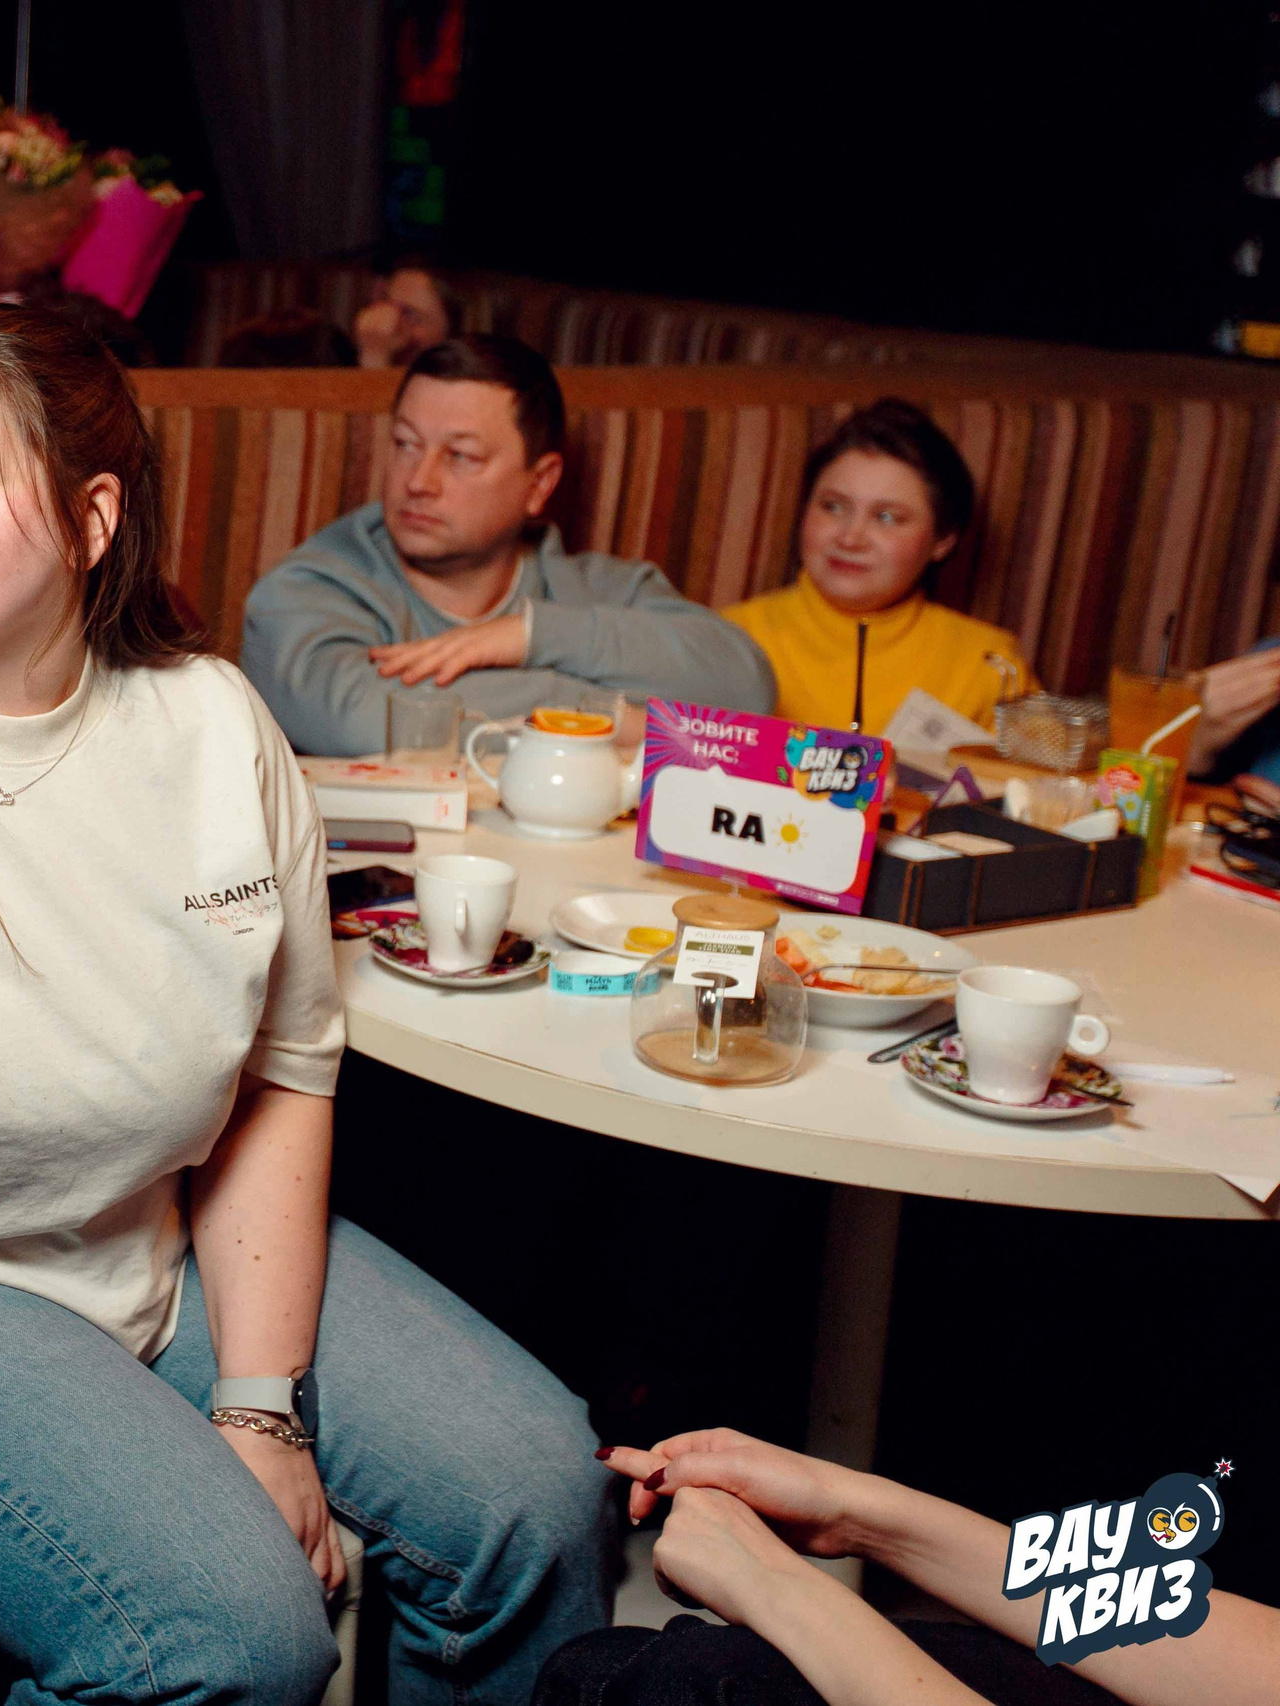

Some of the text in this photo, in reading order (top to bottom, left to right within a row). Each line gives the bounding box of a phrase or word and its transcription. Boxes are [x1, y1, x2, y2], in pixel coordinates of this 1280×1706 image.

[677, 716, 760, 747] ЗОВИТЕ
[798, 746, 843, 772] ВАУ
[806, 769, 859, 792] КВИЗ
[711, 806, 766, 844] RA
